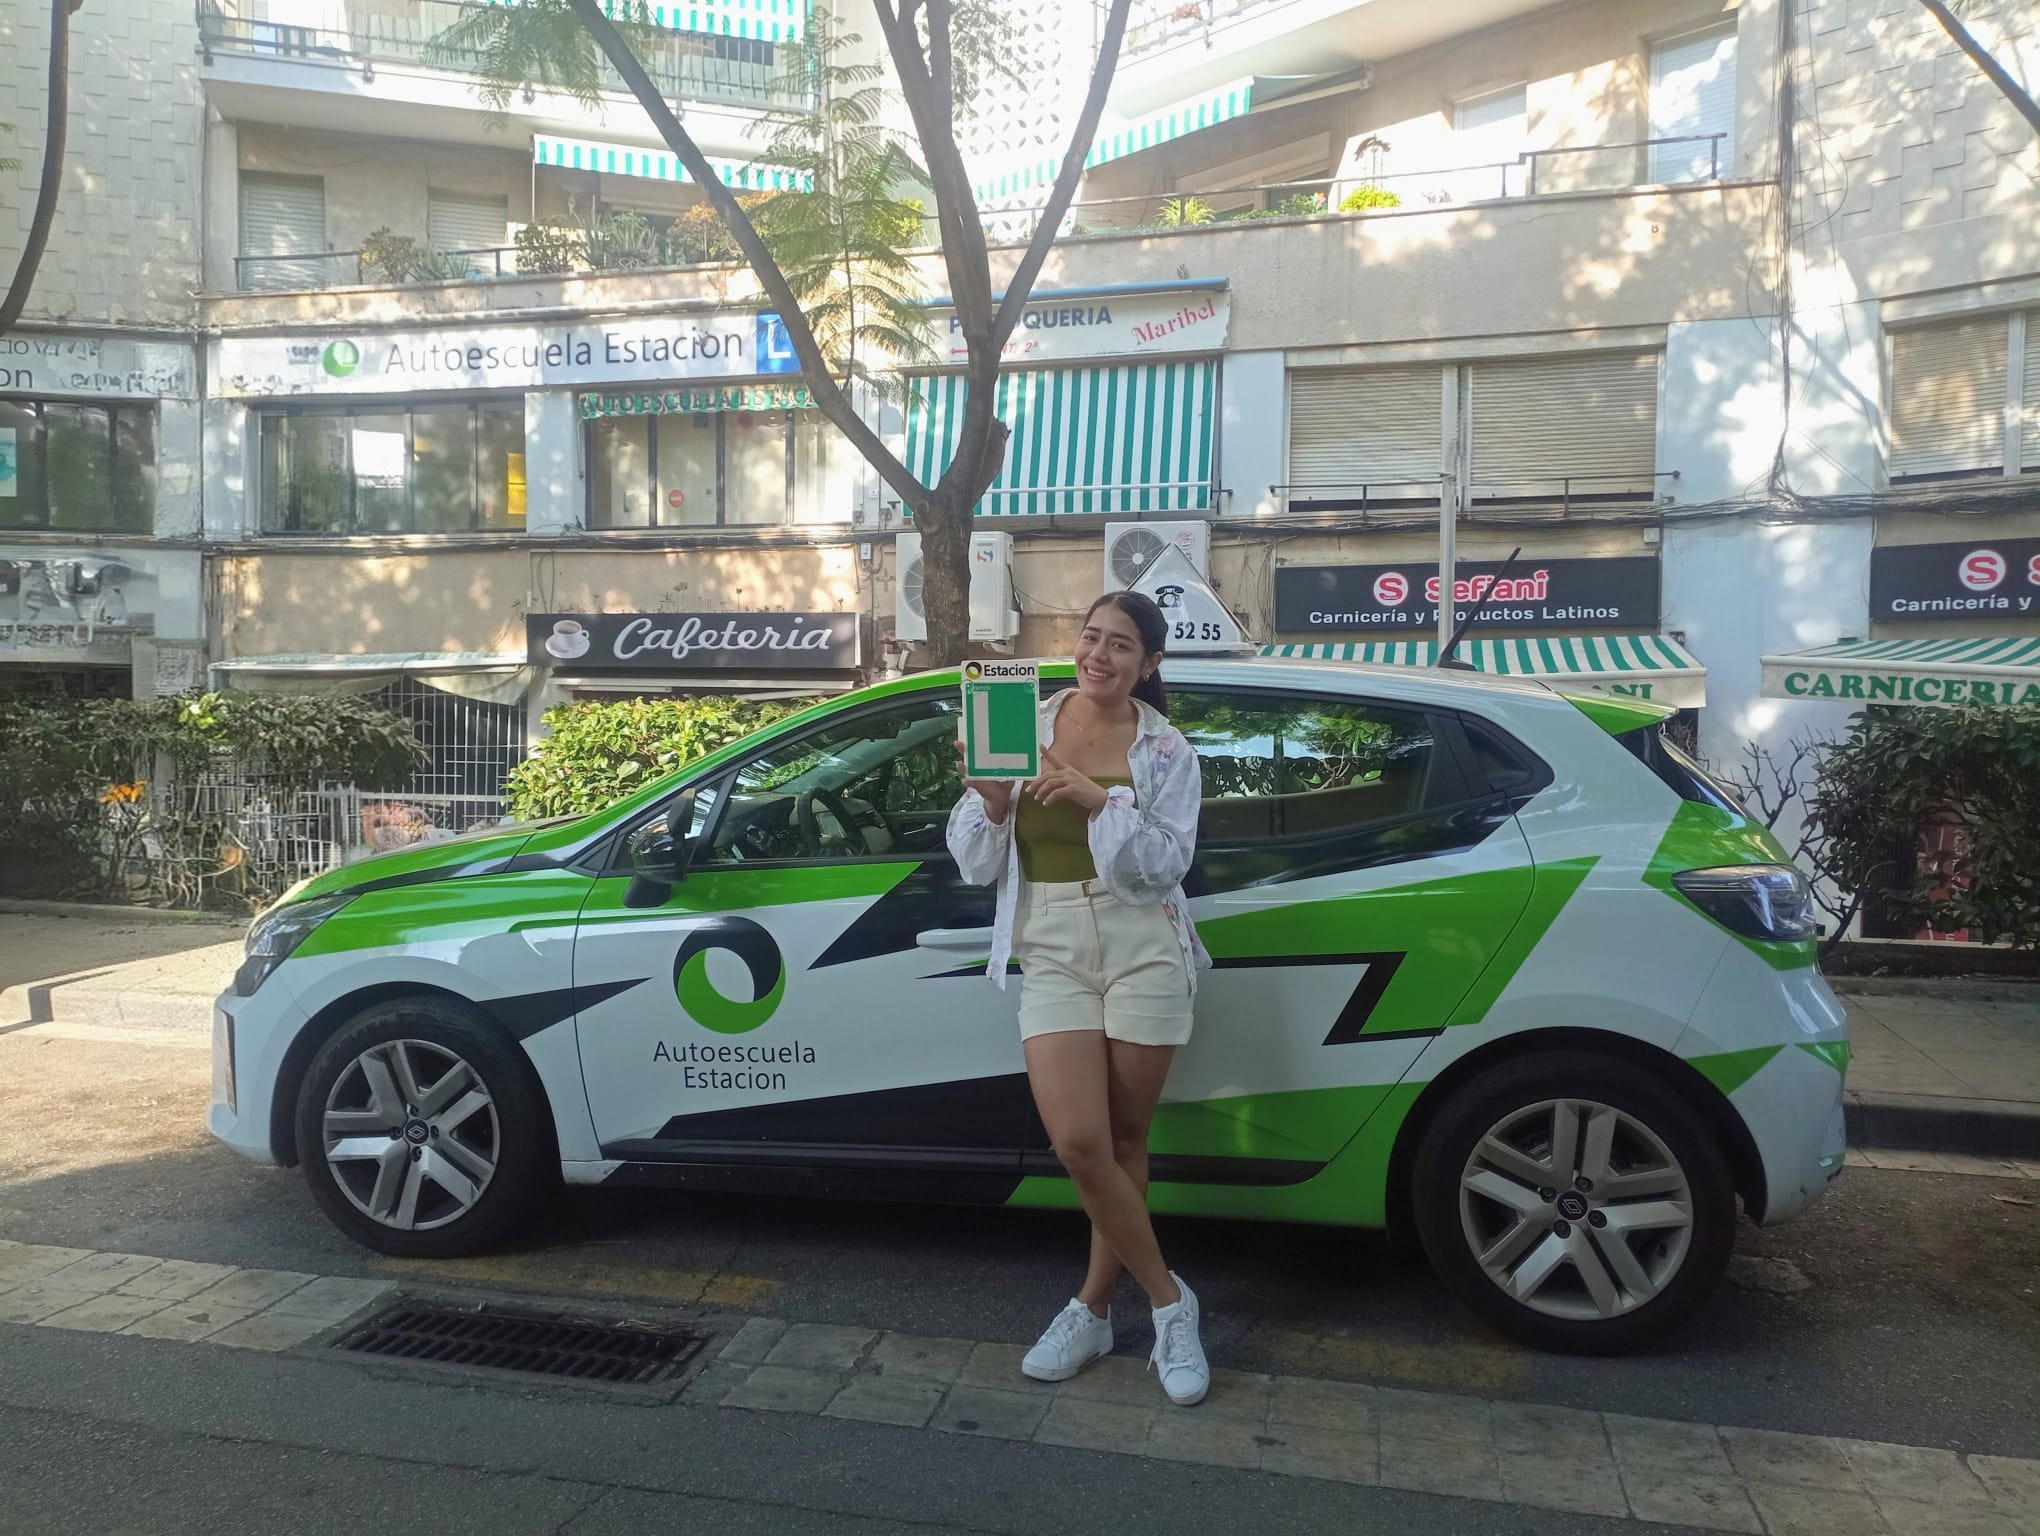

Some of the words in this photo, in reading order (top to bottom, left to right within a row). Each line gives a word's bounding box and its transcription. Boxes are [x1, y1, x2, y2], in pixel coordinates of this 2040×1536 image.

[949, 306, 1112, 334] PQUERIA
[1131, 299, 1216, 346] Maribel
[385, 333, 592, 374] Autoescuela
[604, 326, 743, 364] Estacion
[767, 319, 791, 360] L
[1966, 556, 1999, 584] S
[1378, 577, 1404, 601] S
[1425, 569, 1549, 602] Sefani
[1309, 608, 1407, 624] Carnicería
[1415, 611, 1425, 624] y
[1433, 608, 1534, 622] Pouctos
[1543, 605, 1620, 620] Latinos
[1892, 594, 2009, 612] Carnicería
[2019, 597, 2032, 611] y
[613, 617, 832, 660] Cafeteria
[1174, 621, 1196, 640] 52
[1201, 622, 1221, 641] 55
[984, 664, 1035, 677] Estacion
[1592, 684, 1653, 700] NI
[1784, 672, 2040, 706] CARNICERIA
[973, 690, 1028, 769] L
[653, 1040, 816, 1063] Autoescuela
[684, 1066, 786, 1090] Estacion
